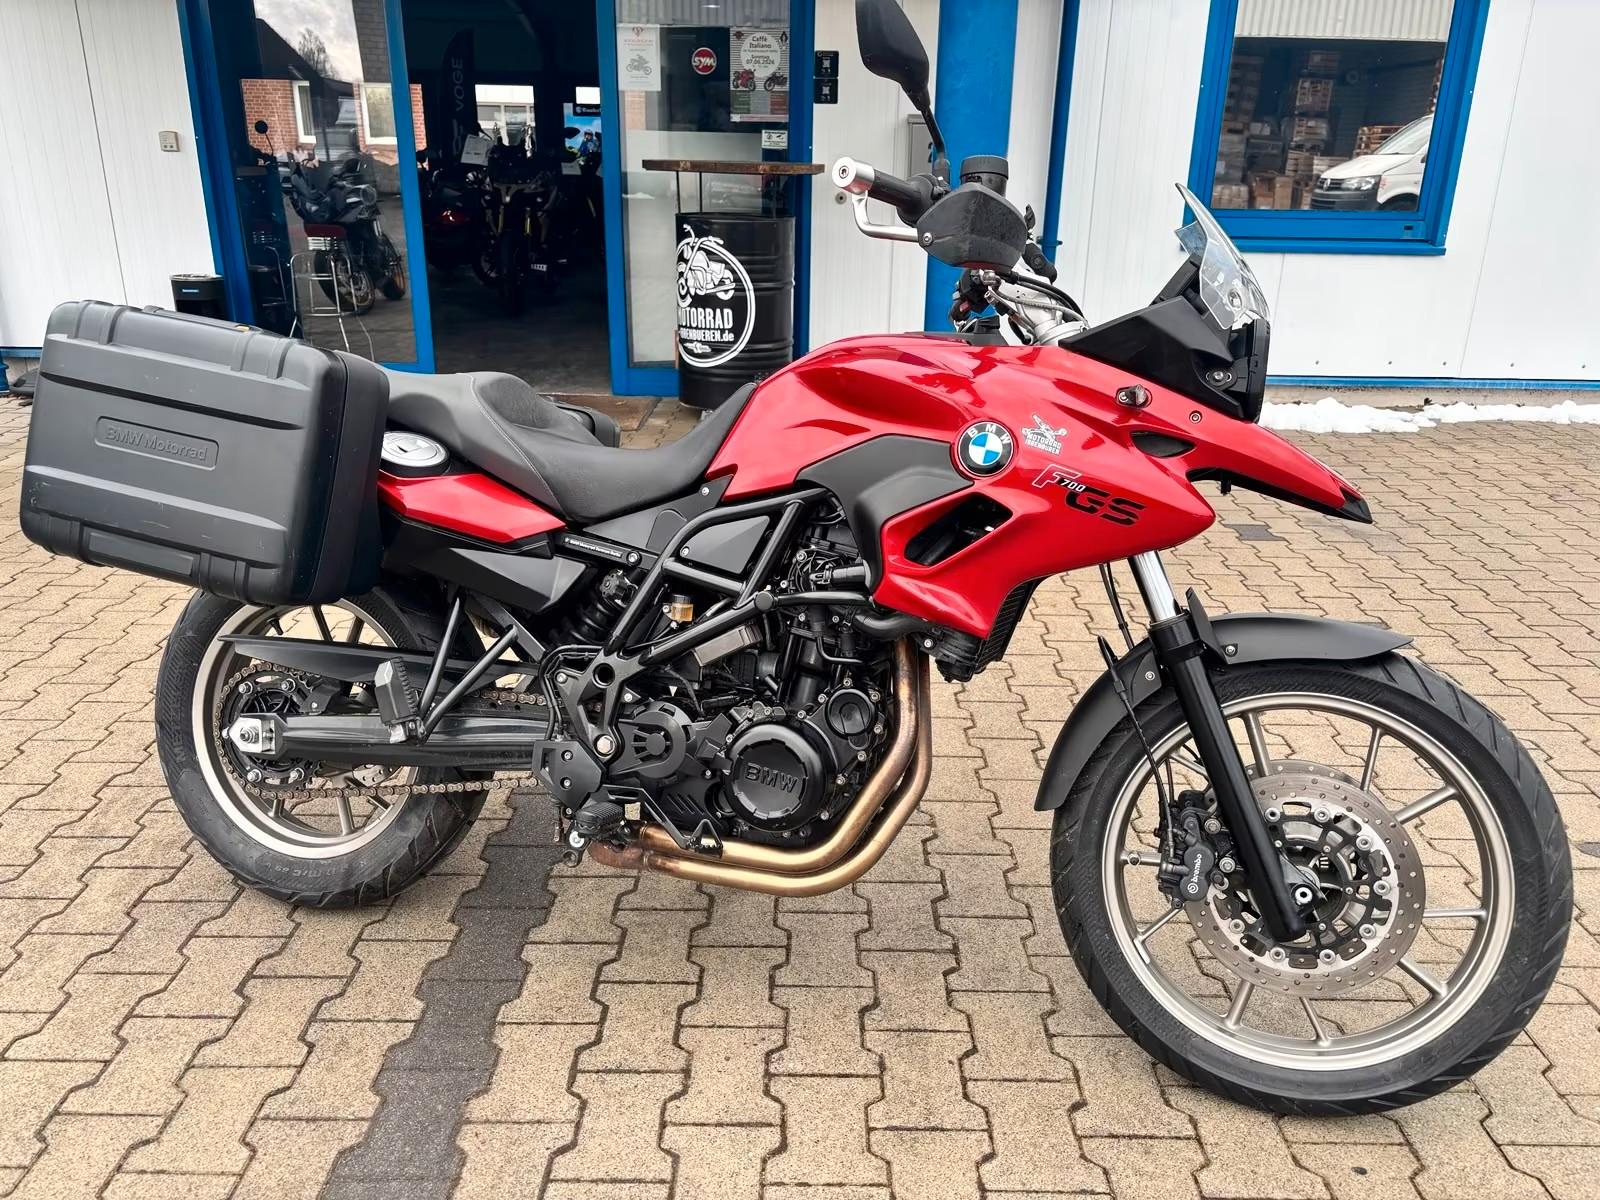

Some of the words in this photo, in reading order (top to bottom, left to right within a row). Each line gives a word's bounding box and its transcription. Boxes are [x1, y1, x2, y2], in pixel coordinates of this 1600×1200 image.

[692, 56, 717, 69] SYM
[451, 57, 465, 112] VOGE
[104, 426, 143, 446] BMW
[144, 435, 208, 461] Motorrad
[967, 423, 1011, 445] BMW
[1032, 463, 1084, 489] F
[1060, 478, 1087, 493] 700
[1064, 486, 1147, 526] GS
[745, 762, 799, 793] BMW
[1191, 853, 1203, 883] brembo
